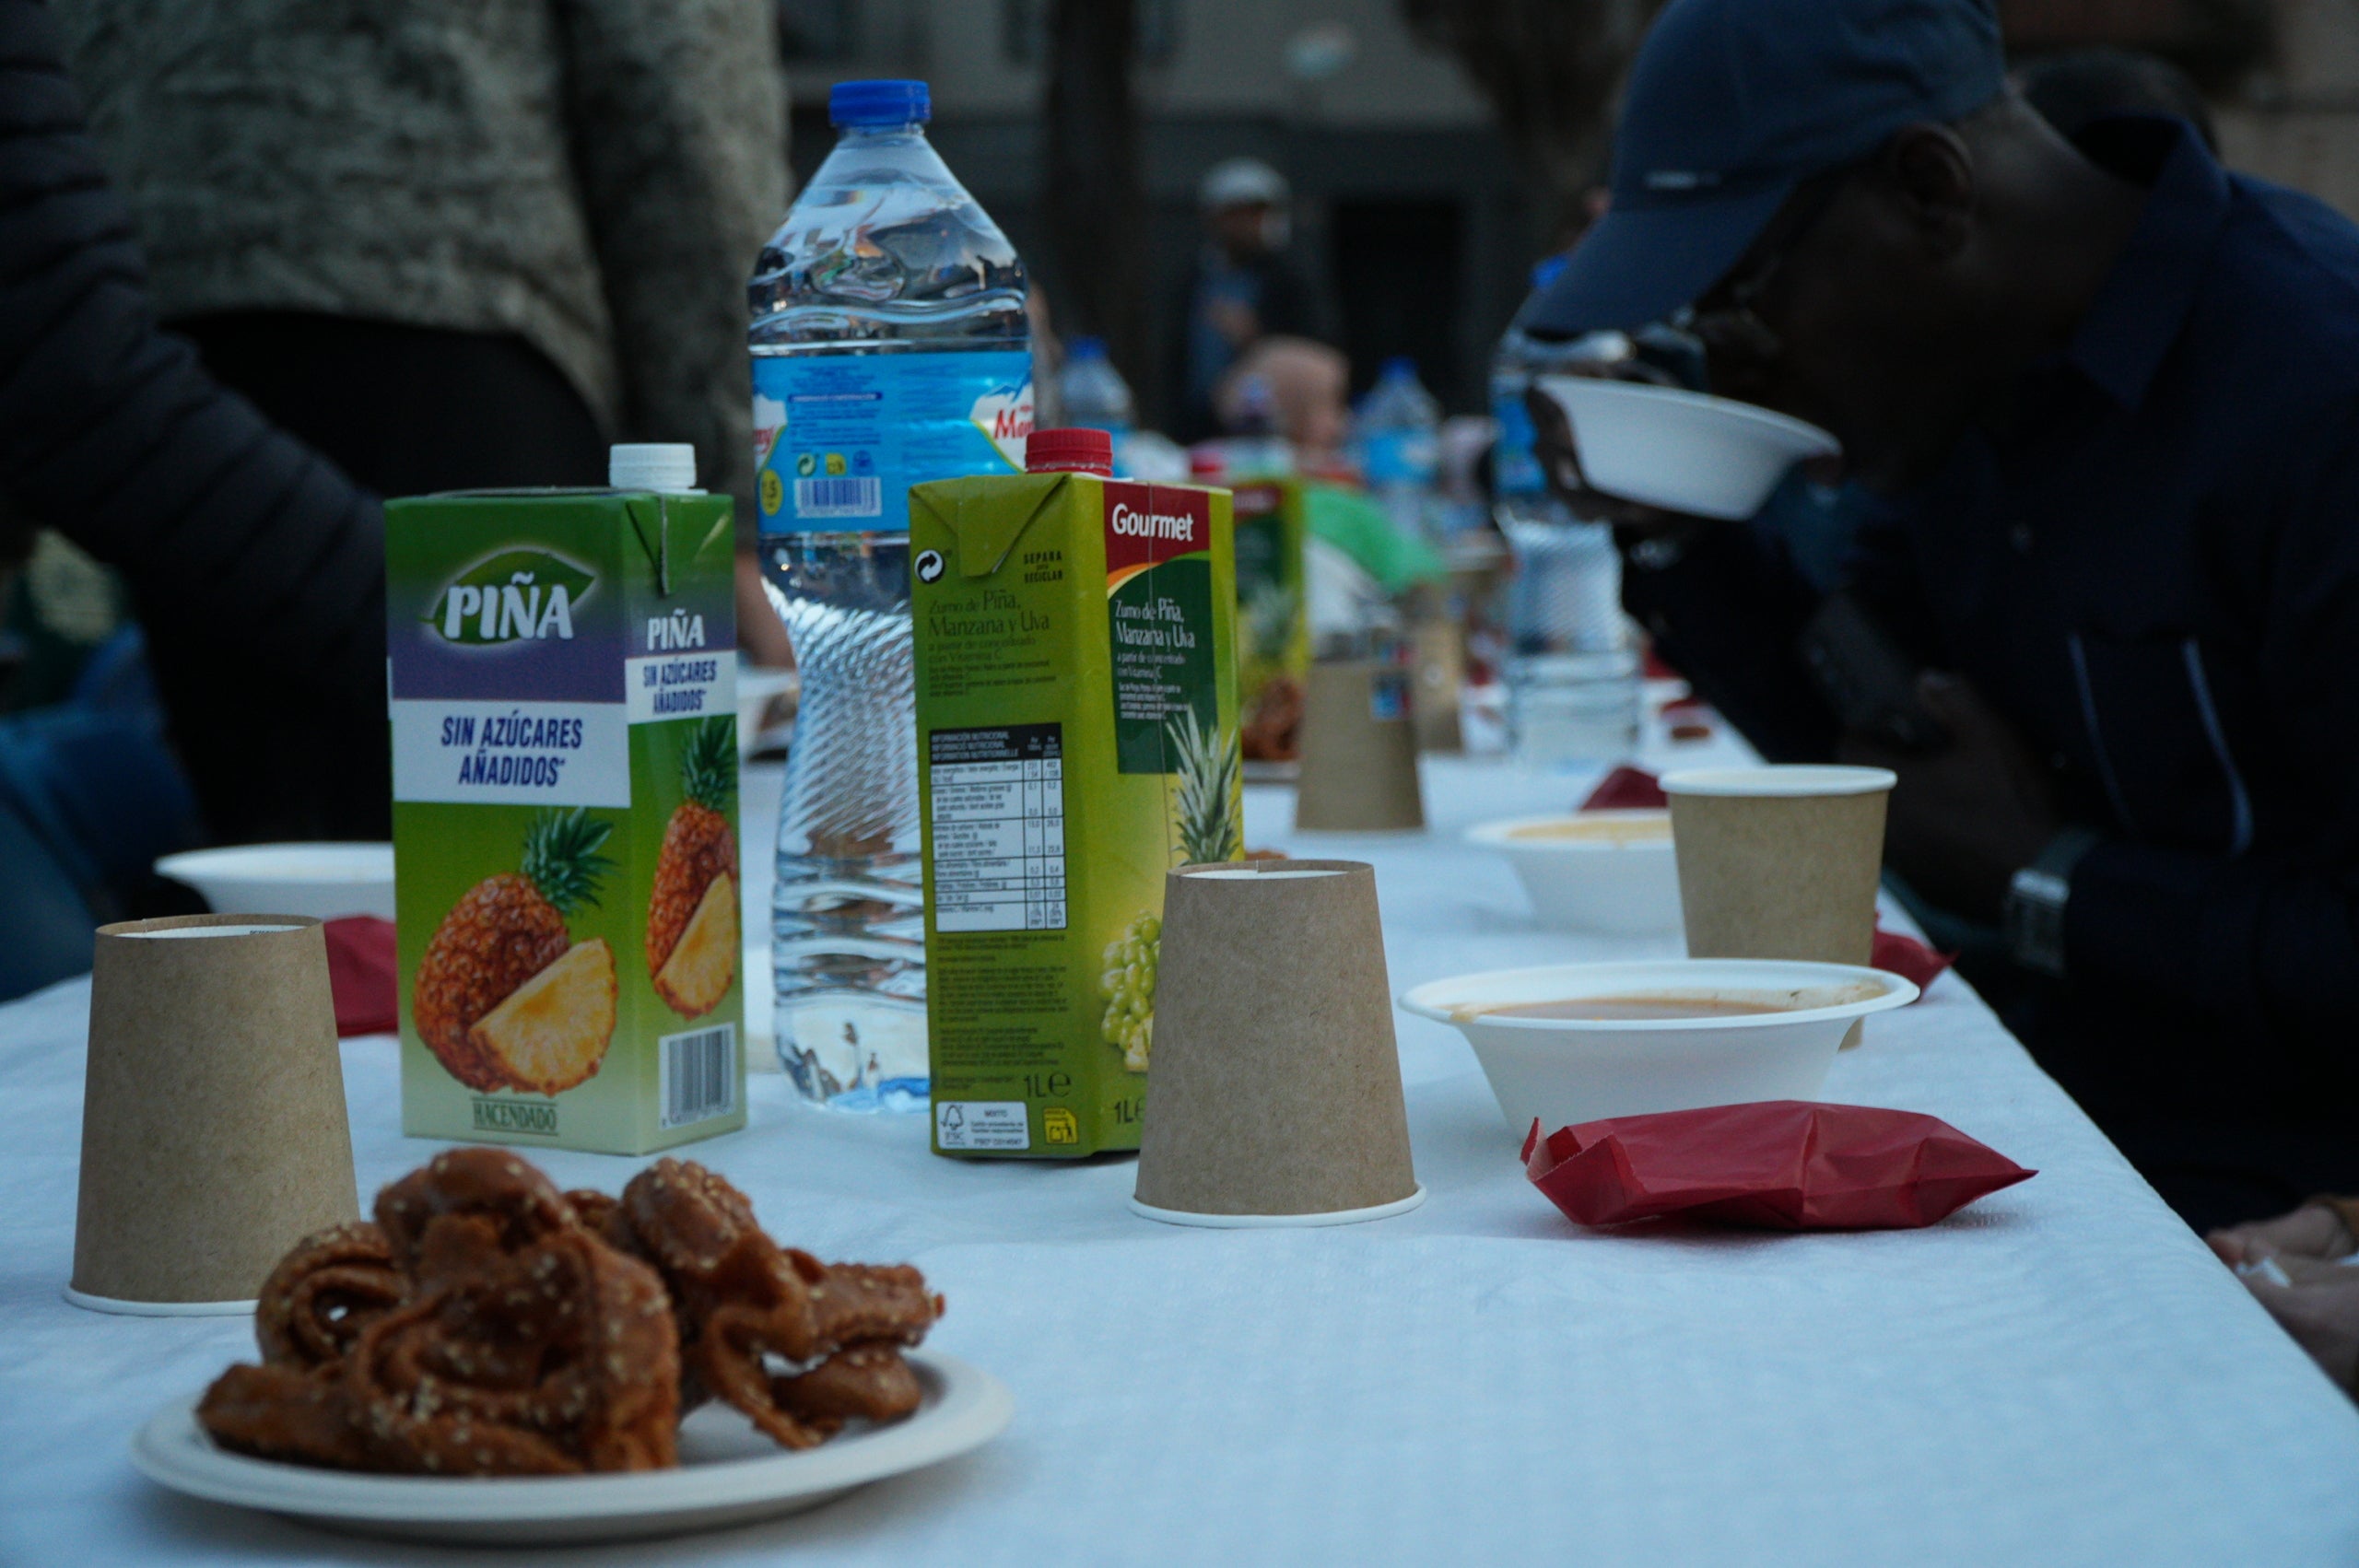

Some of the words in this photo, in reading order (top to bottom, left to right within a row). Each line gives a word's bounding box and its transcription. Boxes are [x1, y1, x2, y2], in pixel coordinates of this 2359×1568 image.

[1112, 502, 1194, 542] Gourmet
[1024, 550, 1062, 565] SEPARA
[1024, 569, 1063, 583] RECICLAR
[442, 570, 574, 642] PIÑA
[983, 589, 1021, 611] Piña,
[1115, 599, 1141, 619] Zumo
[1142, 602, 1156, 621] de
[1157, 596, 1185, 624] Piña,
[646, 608, 706, 651] PIÑA
[929, 615, 1004, 637] Manzana
[1007, 619, 1017, 632] y
[1020, 609, 1050, 631] Uva
[1115, 621, 1165, 647] Manzana
[1165, 631, 1172, 653] y
[1172, 624, 1196, 649] Uva
[642, 664, 659, 687] SIN
[659, 657, 717, 685] AZÚCARES
[441, 716, 475, 747] SIN
[480, 708, 583, 750] AZÚCARES
[473, 1103, 557, 1131] HACENDADO
